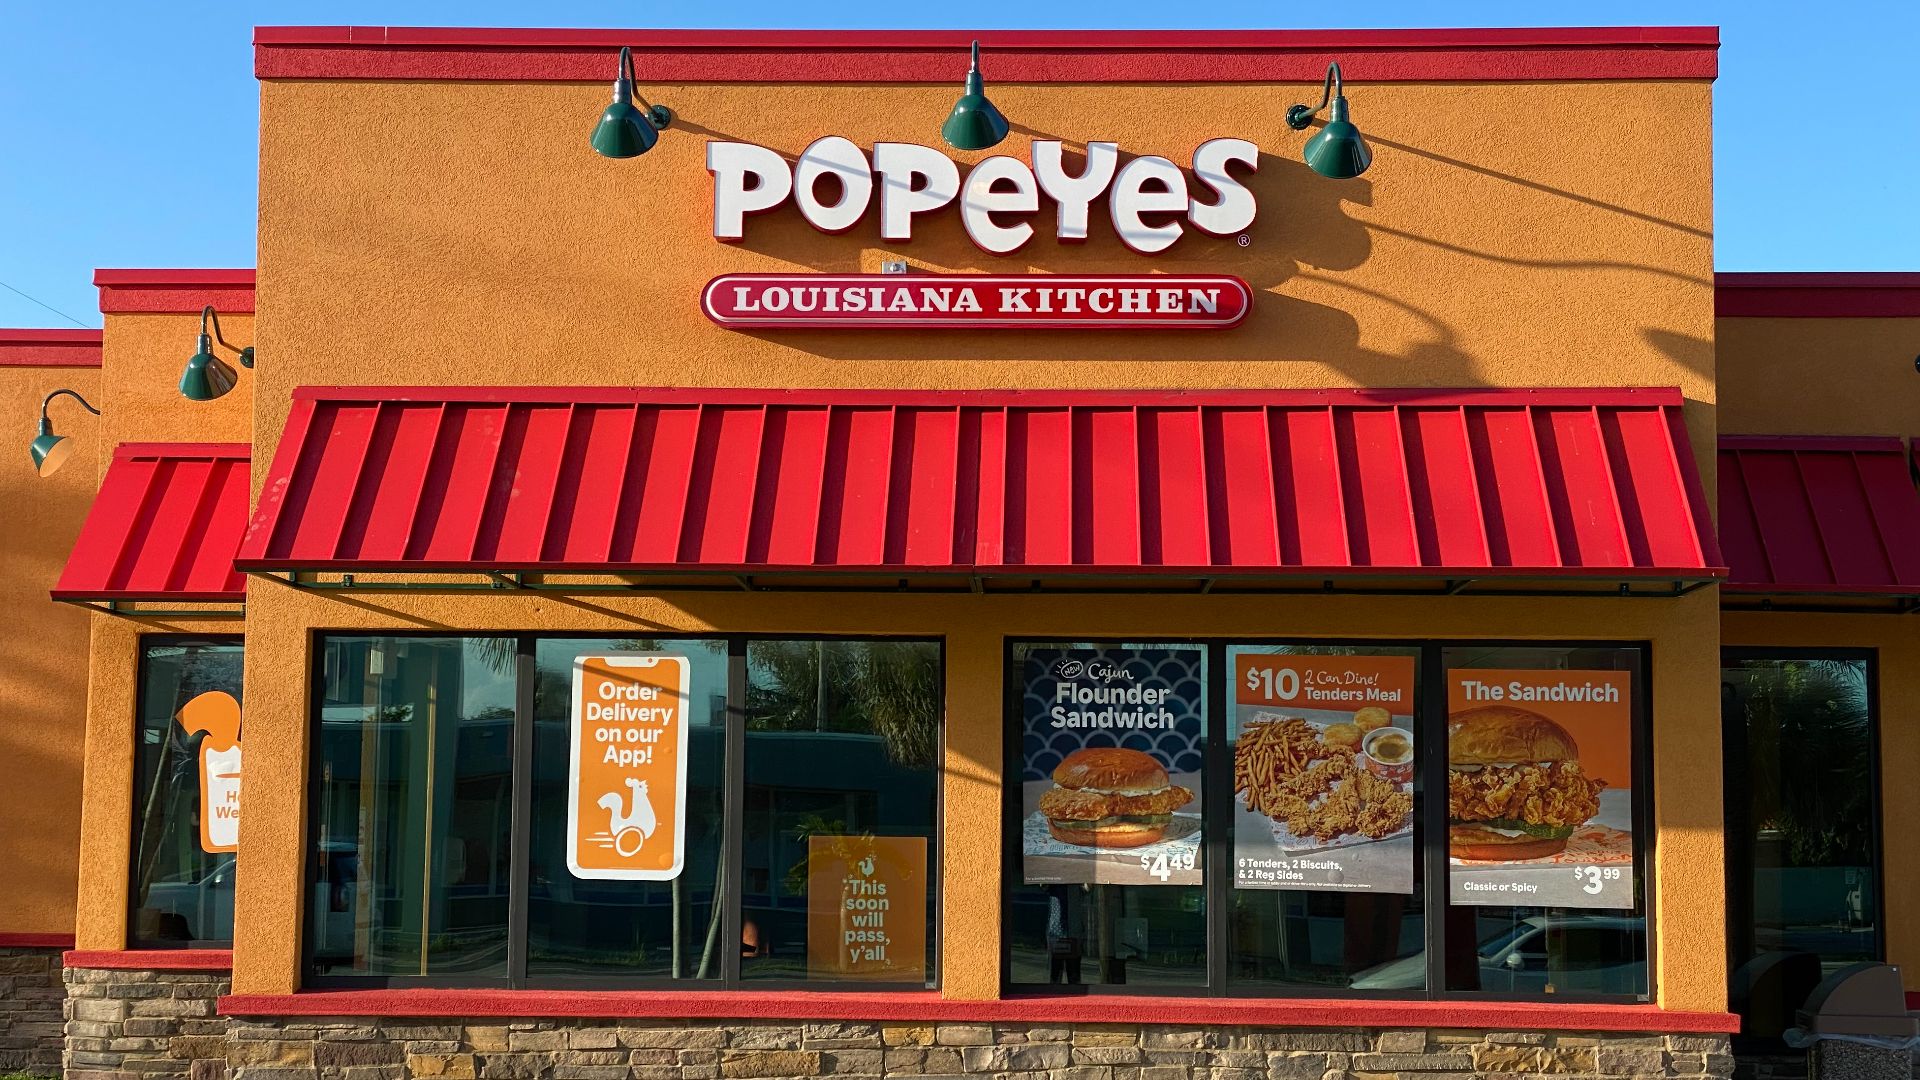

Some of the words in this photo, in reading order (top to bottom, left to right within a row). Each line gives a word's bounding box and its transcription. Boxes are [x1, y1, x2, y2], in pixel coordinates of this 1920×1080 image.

[733, 286, 982, 313] LOUISIANA
[998, 288, 1219, 314] KITCHEN
[1088, 663, 1134, 683] Cajun
[1304, 670, 1314, 685] 2
[1317, 671, 1343, 685] Can
[1344, 671, 1379, 686] Dine!
[598, 682, 663, 701] Order
[1246, 667, 1300, 701] $10
[1461, 680, 1504, 701] The
[1508, 681, 1619, 703] Sandwich
[1056, 682, 1171, 704] Flounder
[1304, 687, 1364, 701] Tenders
[1366, 688, 1401, 702] Meal
[586, 702, 673, 726] Delivery
[1050, 706, 1174, 729] Sandwich
[595, 727, 621, 743] on
[626, 727, 663, 743] our
[603, 745, 652, 767] App!
[1238, 858, 1246, 867] 6
[1247, 859, 1291, 870] Tenders,
[1292, 860, 1298, 869] 2
[1300, 860, 1343, 872] Biscuits,
[1238, 870, 1246, 879] &
[1248, 870, 1254, 879] 2
[1256, 870, 1275, 881] Reg
[1277, 870, 1303, 880] Sides
[848, 880, 886, 895] This
[1464, 882, 1497, 891] Classic
[1499, 884, 1510, 892] or
[1512, 883, 1538, 894] Spicy
[846, 898, 889, 911] soon
[852, 912, 884, 927] will
[845, 930, 891, 945] pass,
